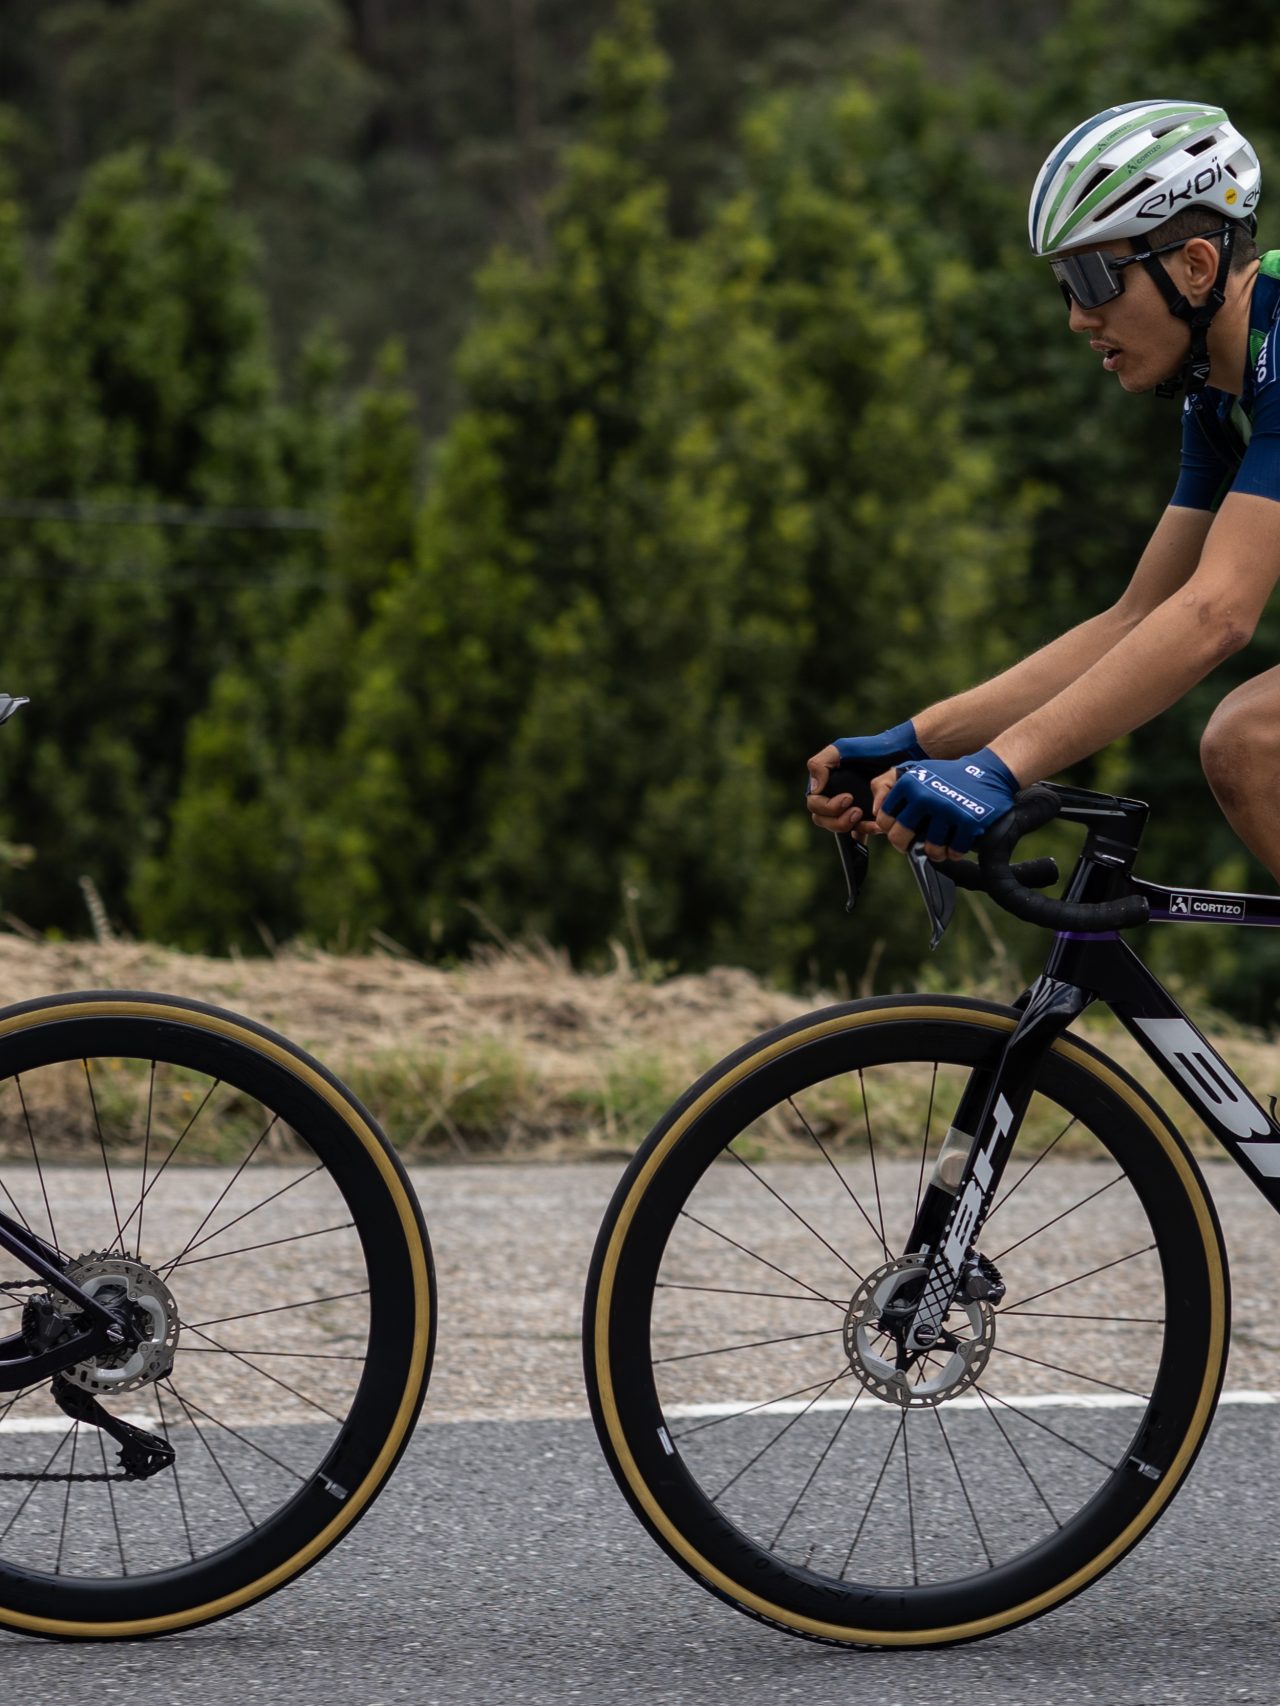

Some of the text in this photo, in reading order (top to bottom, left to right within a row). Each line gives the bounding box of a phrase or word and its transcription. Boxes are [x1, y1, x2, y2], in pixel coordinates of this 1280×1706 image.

[930, 780, 985, 815] CORTIZO
[1193, 902, 1242, 915] CORTIZO
[943, 1091, 1015, 1281] BH
